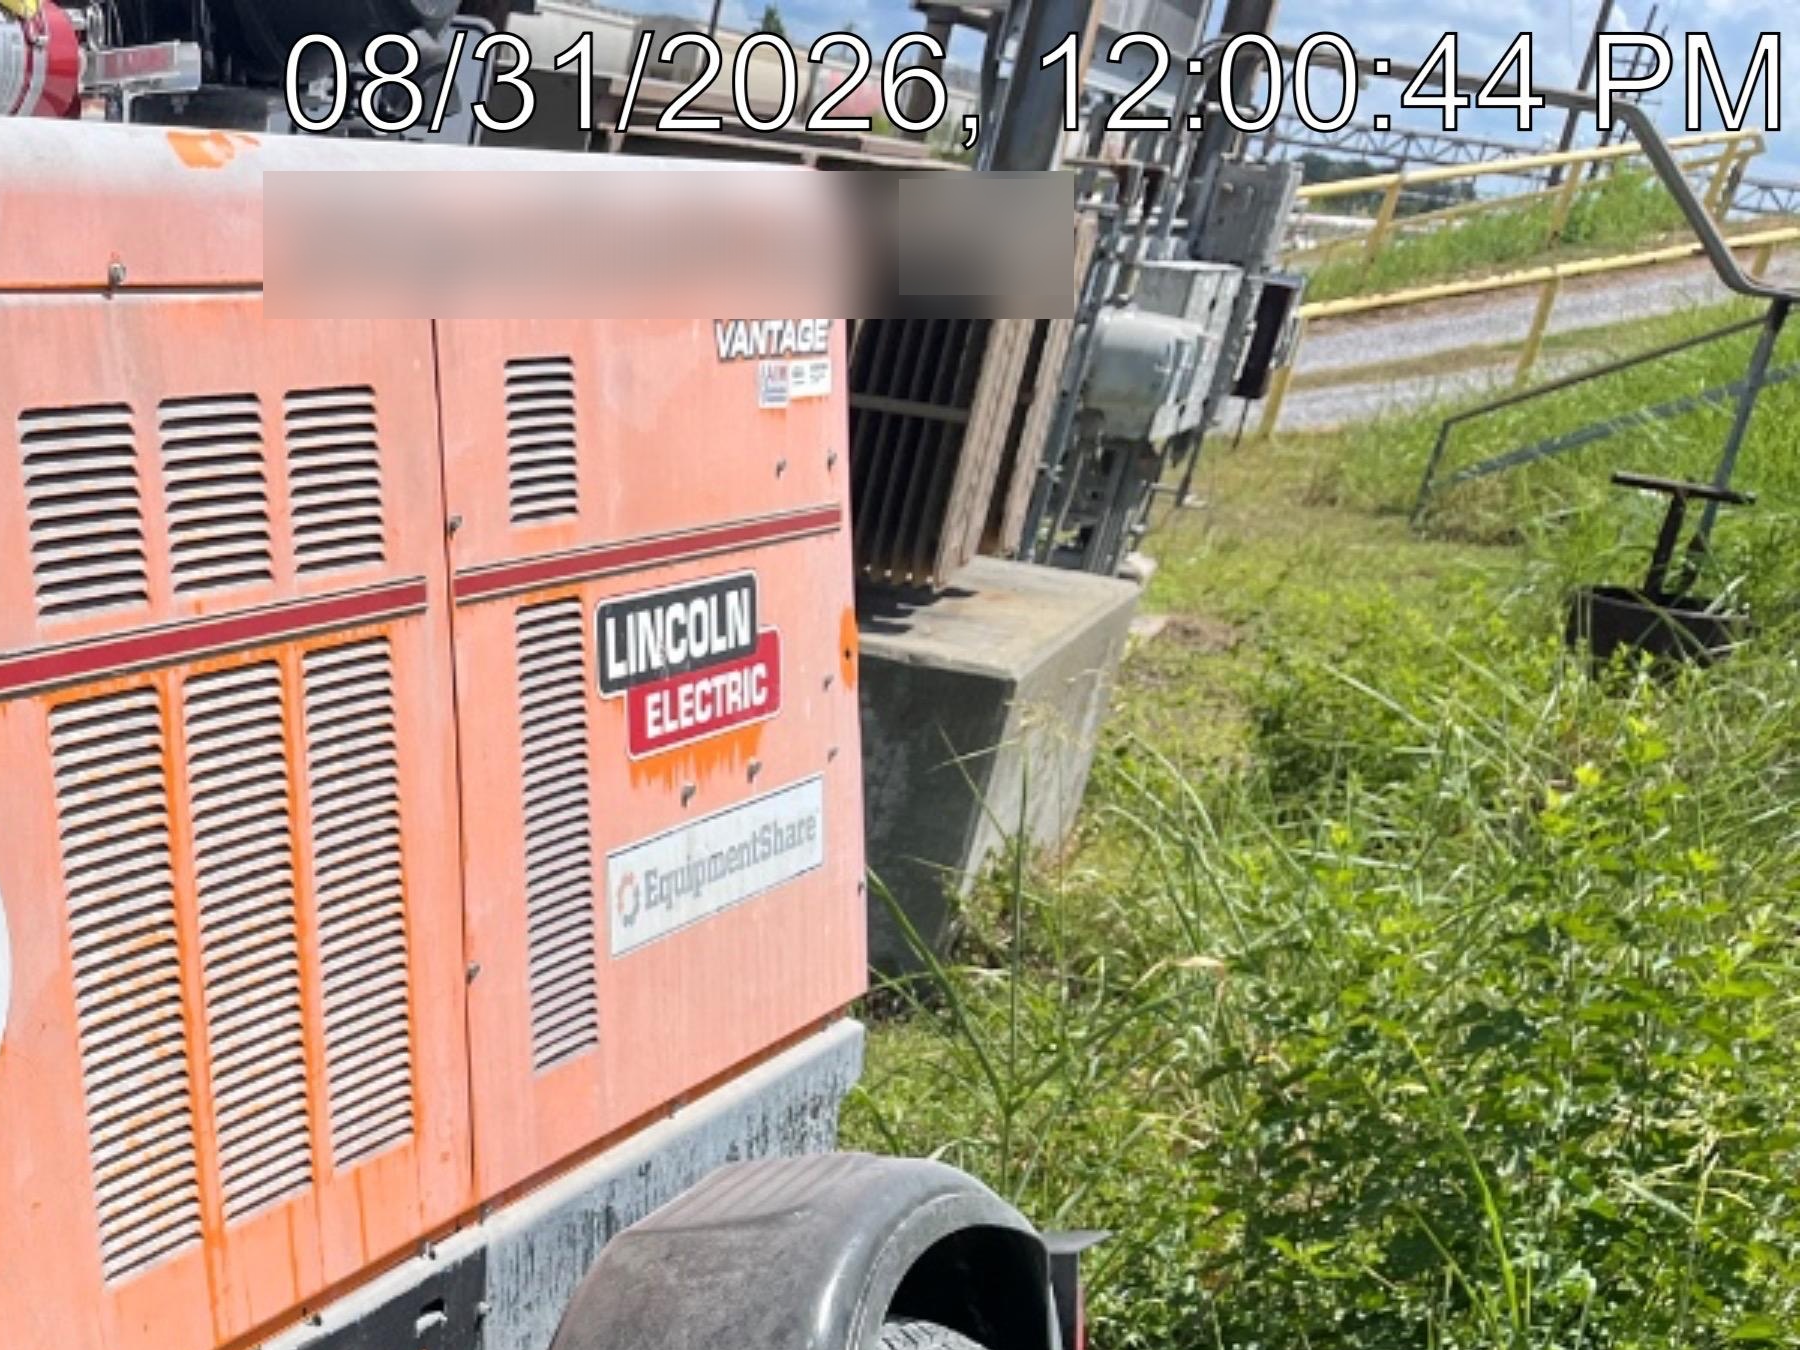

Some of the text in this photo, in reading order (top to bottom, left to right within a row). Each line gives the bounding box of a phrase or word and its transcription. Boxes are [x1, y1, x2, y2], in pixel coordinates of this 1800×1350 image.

[714, 319, 831, 361] VANTAGE
[604, 586, 752, 680] LINCOLN
[645, 663, 769, 740] ELECTRIC
[644, 814, 817, 911] EquipmentShare
